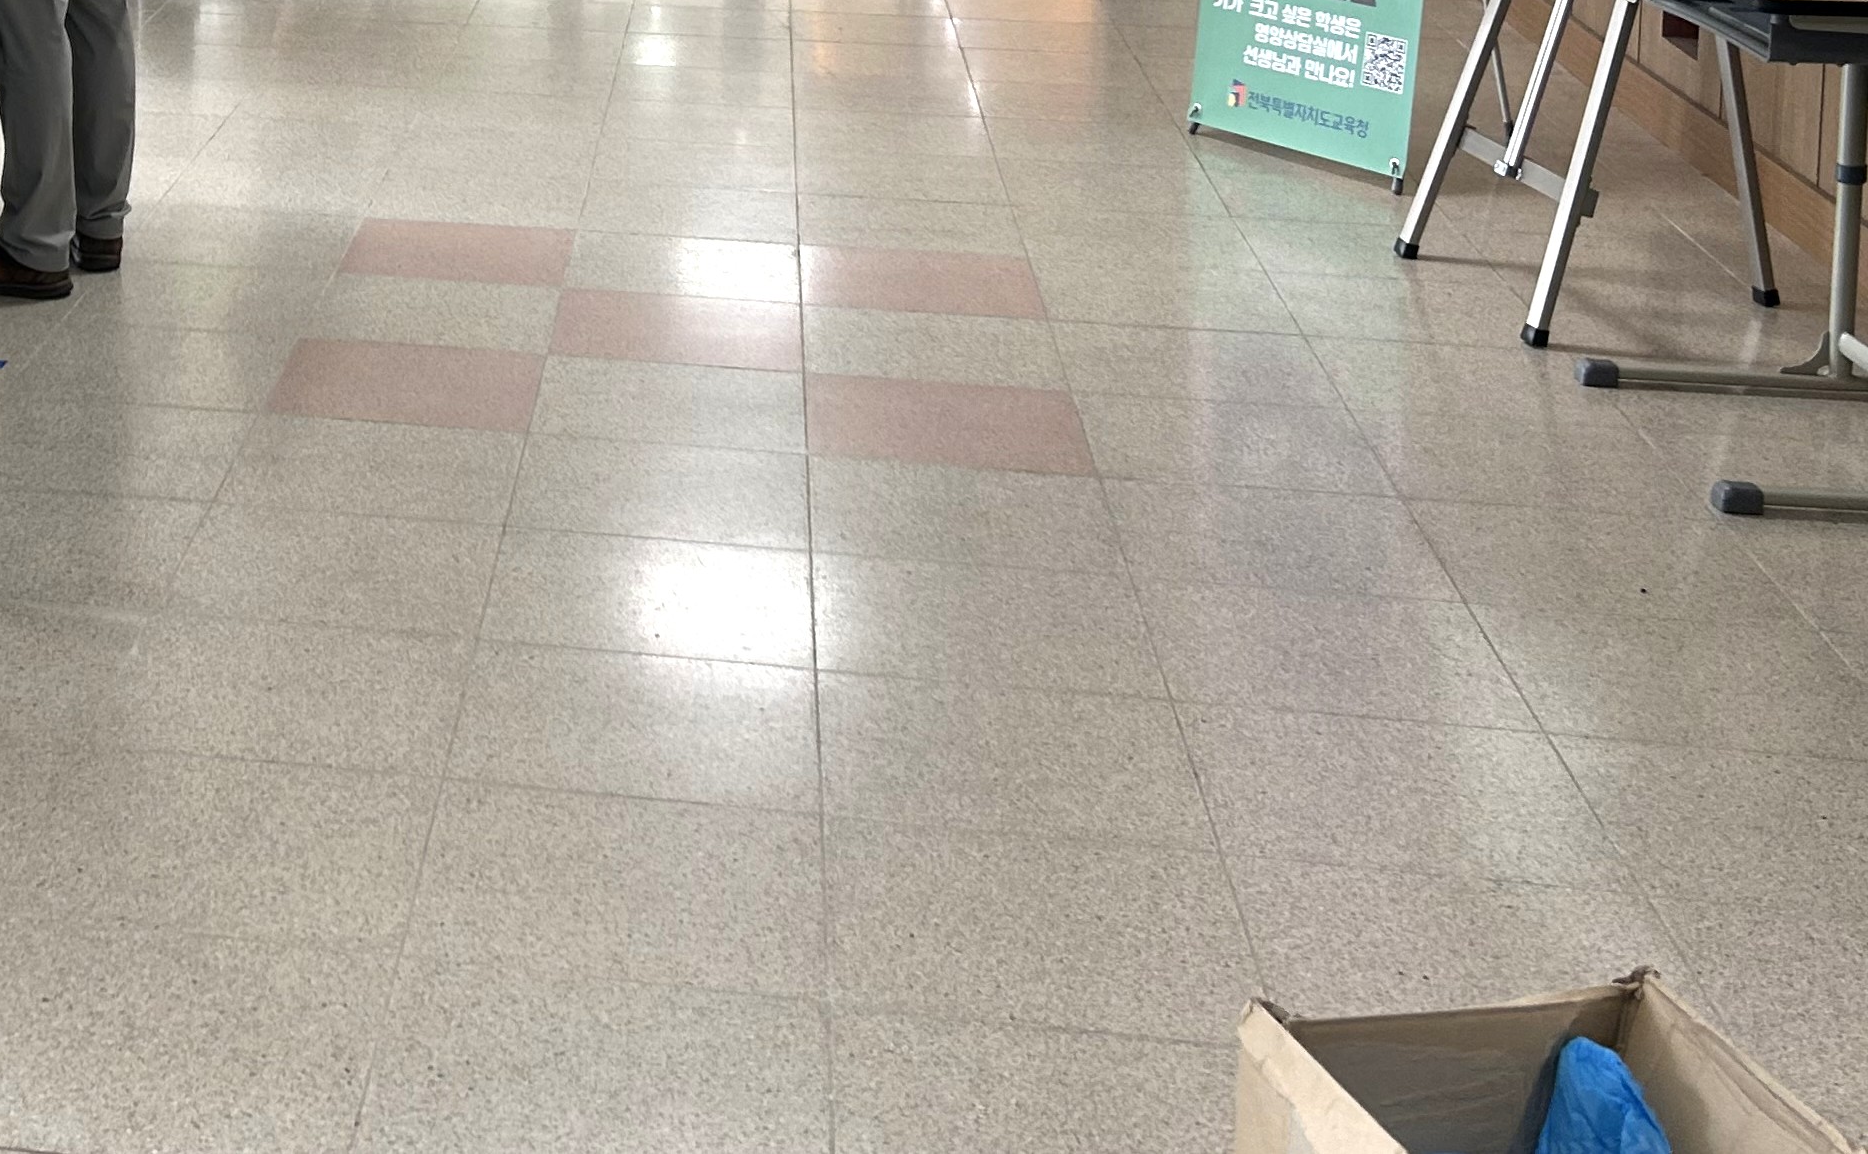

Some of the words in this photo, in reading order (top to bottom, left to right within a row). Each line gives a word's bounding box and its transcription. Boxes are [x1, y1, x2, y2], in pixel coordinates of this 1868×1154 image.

[1281, 3, 1312, 29] 싶은
[1315, 11, 1362, 39] 학생은
[1254, 22, 1358, 65] 영양상담실에서
[1242, 45, 1302, 76] 선생님과
[1304, 59, 1355, 88] 만나요!
[1248, 90, 1370, 139] 전북특별자치도교육청
